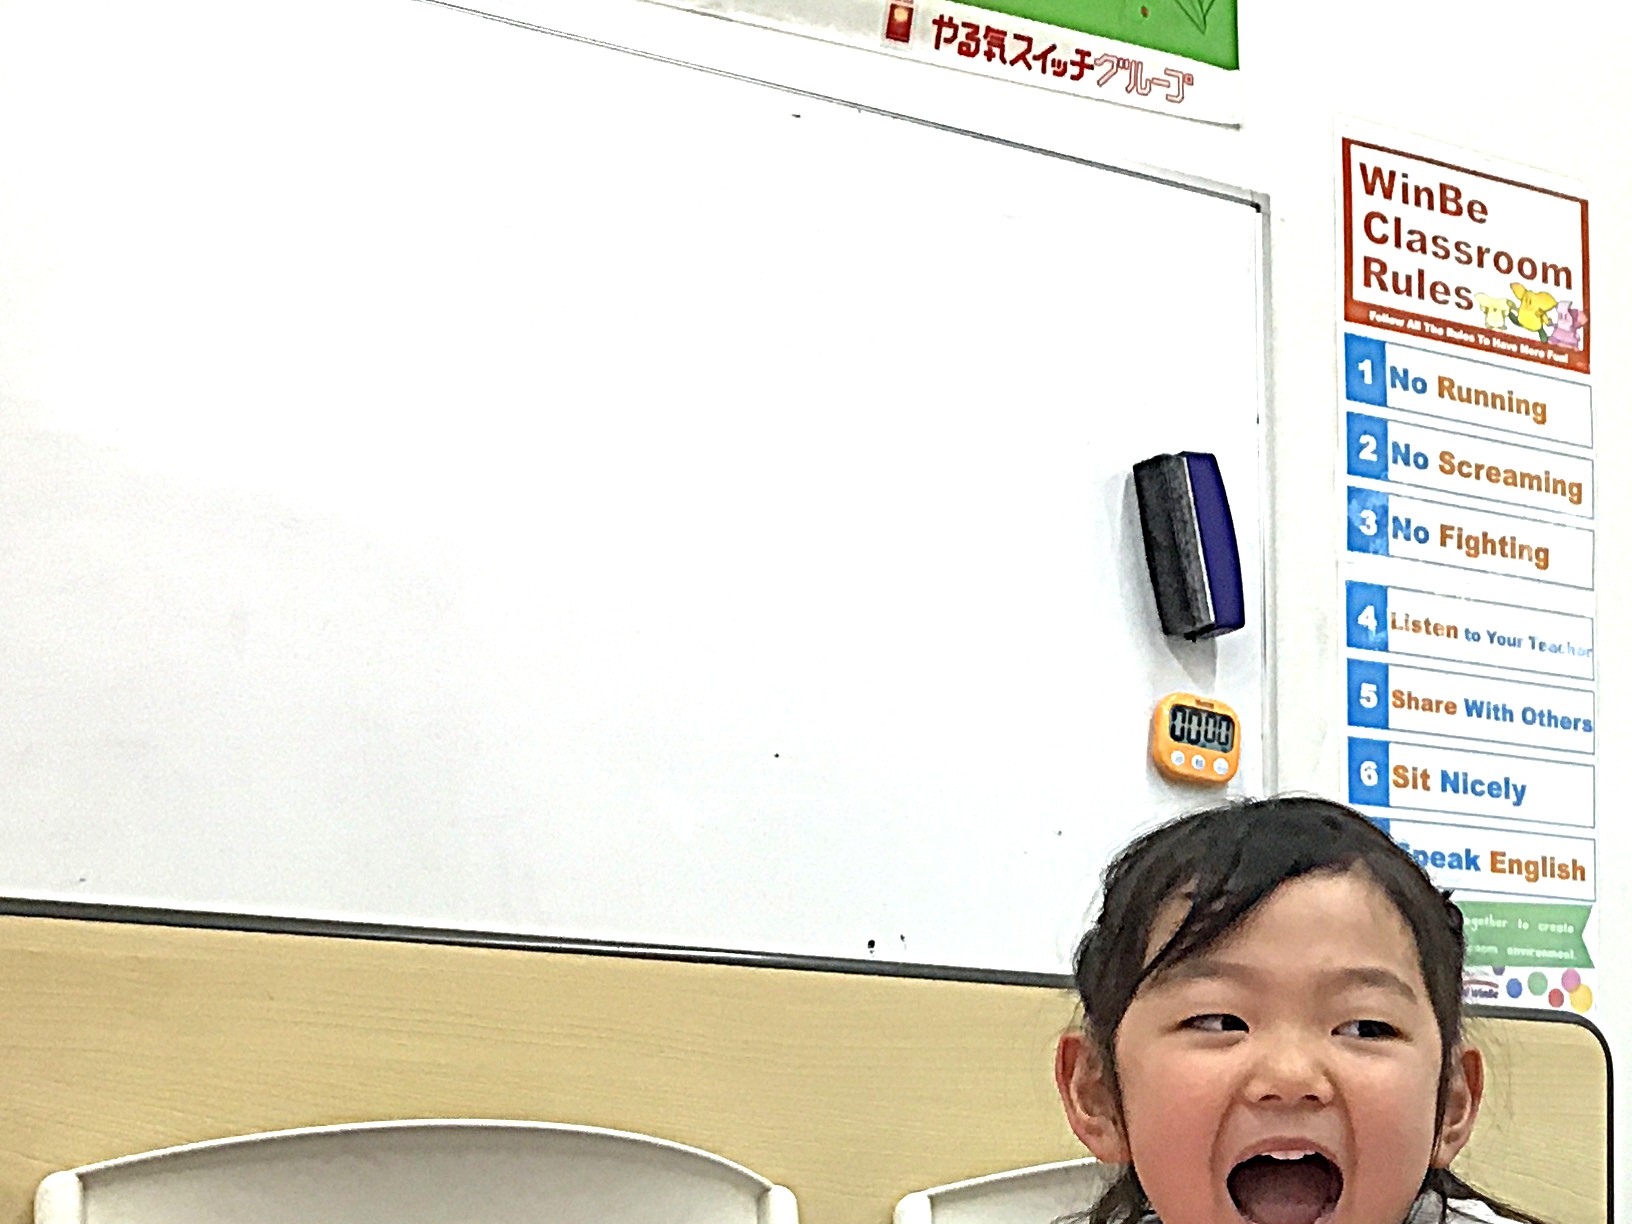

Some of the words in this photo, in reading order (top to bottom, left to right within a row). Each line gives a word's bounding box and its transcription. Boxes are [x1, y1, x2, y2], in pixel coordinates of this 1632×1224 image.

[931, 14, 1194, 103] やる気スイッチグループ
[1359, 161, 1489, 224] WinBe
[1363, 210, 1573, 290] Classroom
[1363, 255, 1474, 311] Rules
[1369, 310, 1405, 328] Follow
[1407, 318, 1422, 331] All
[1423, 320, 1444, 337] The
[1446, 326, 1475, 343] Rules
[1478, 331, 1491, 346] To
[1492, 336, 1518, 352] Have
[1520, 343, 1545, 359] More
[1357, 358, 1373, 384] 1
[1390, 365, 1428, 394] No
[1437, 375, 1547, 425] Running
[1358, 433, 1378, 462] 2
[1391, 440, 1429, 470] No
[1438, 450, 1583, 505] Screaming
[1358, 509, 1378, 536] 3
[1391, 515, 1430, 544] No
[1439, 523, 1550, 570] Fighting
[1357, 604, 1378, 635] 4
[1390, 612, 1458, 639] Listen
[1464, 627, 1481, 642] to
[1486, 630, 1523, 649] Your
[1358, 682, 1378, 709] 5
[1391, 688, 1457, 715] Share
[1463, 697, 1514, 722] With
[1521, 706, 1593, 733] Others
[1359, 759, 1379, 787] 6
[1391, 764, 1431, 792] Sit
[1440, 769, 1527, 807] Nicely
[1490, 849, 1586, 884] English
[1518, 918, 1530, 931] to
[1538, 922, 1575, 934] create
